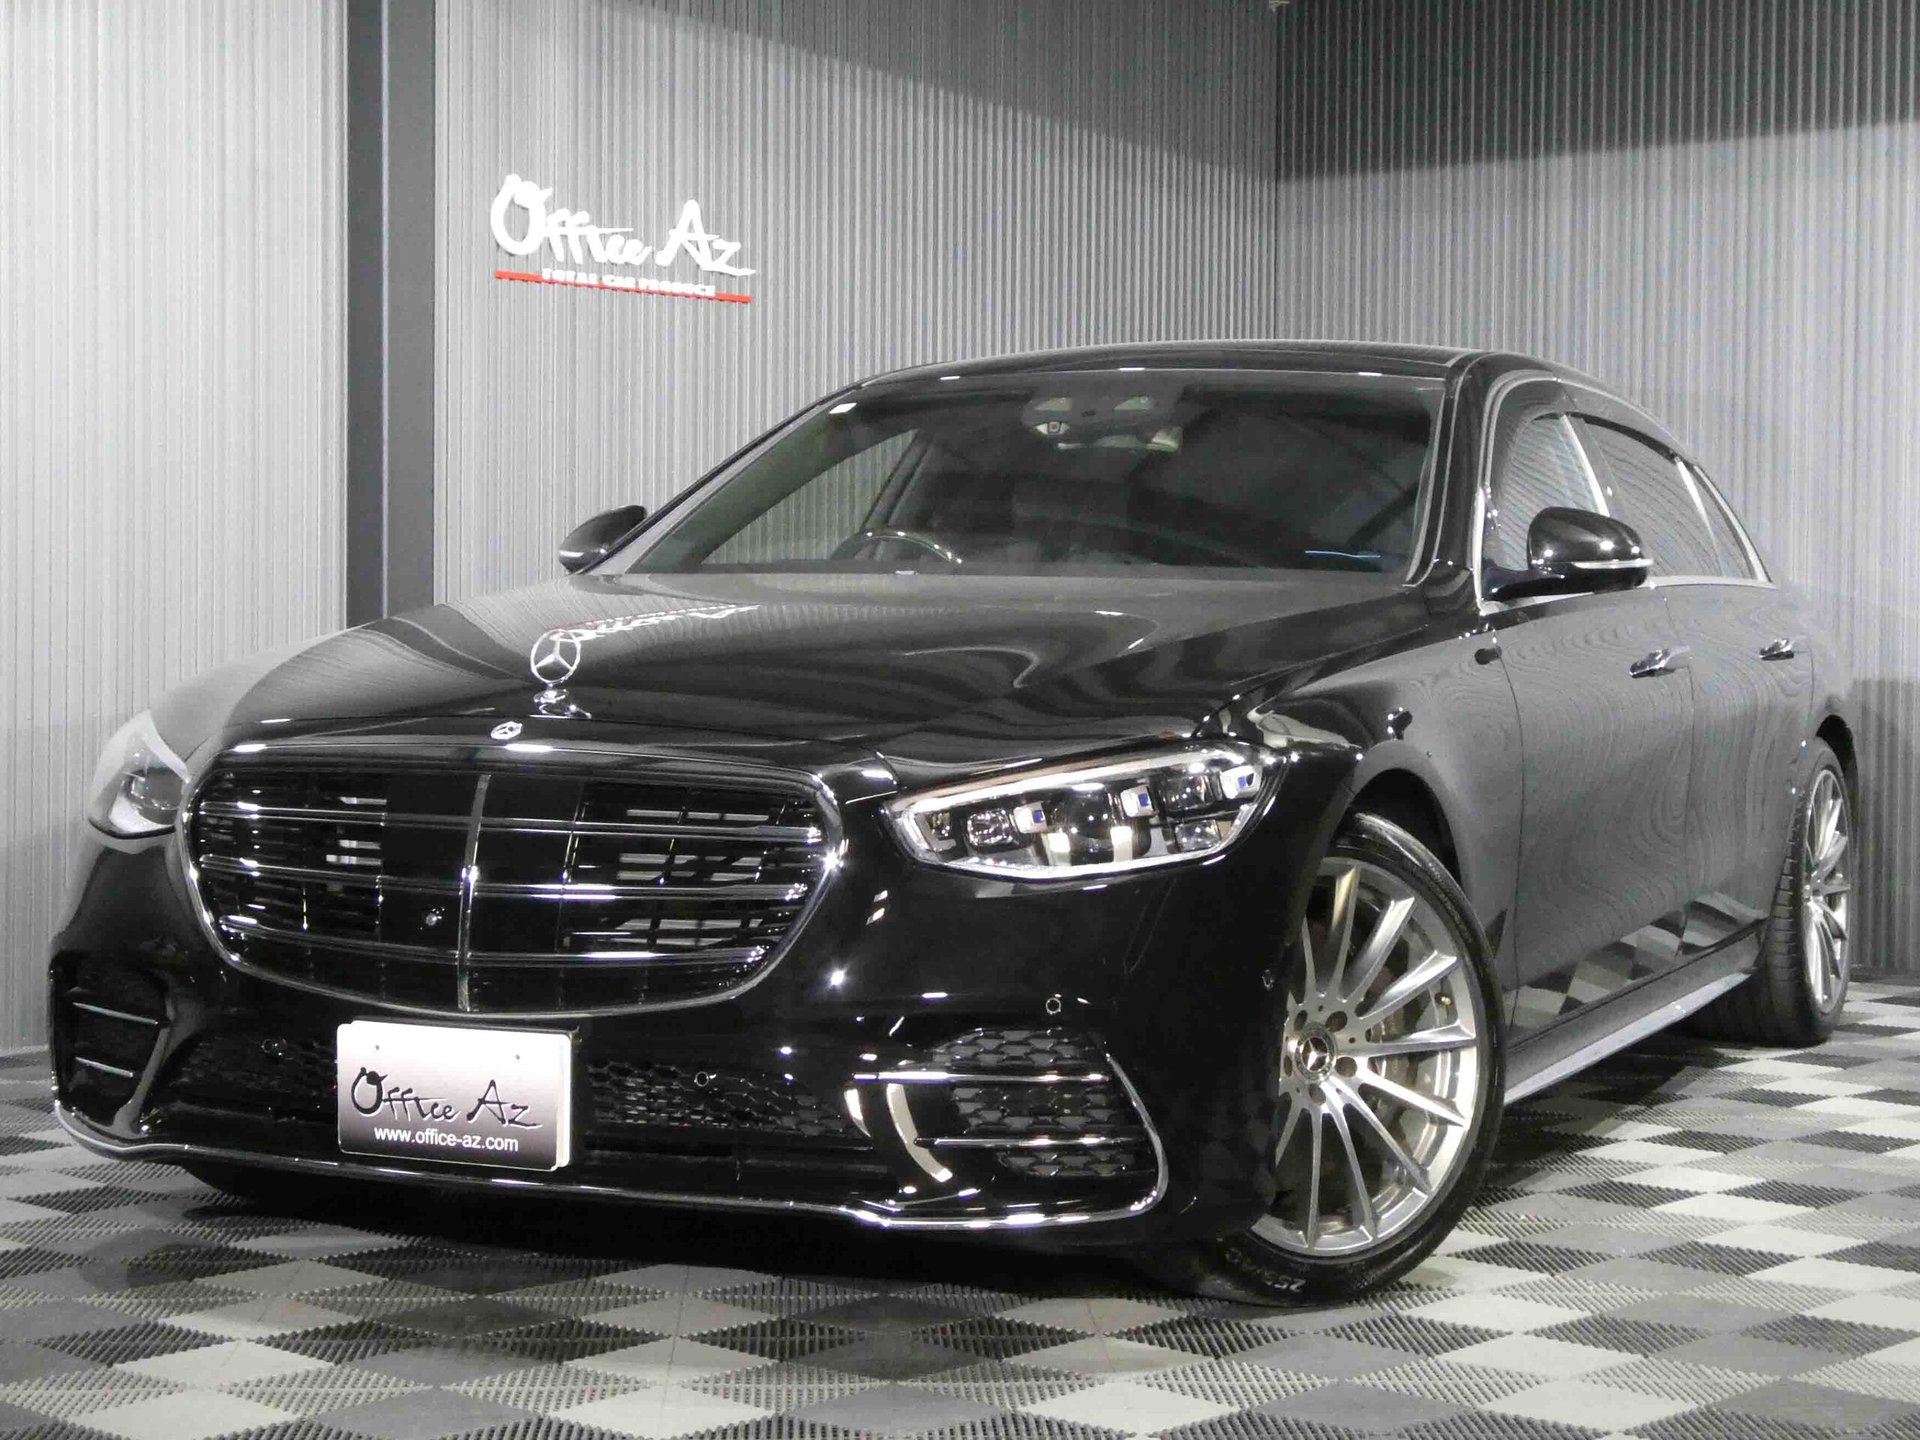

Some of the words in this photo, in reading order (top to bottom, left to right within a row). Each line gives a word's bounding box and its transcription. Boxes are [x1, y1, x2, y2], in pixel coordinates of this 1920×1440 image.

[490, 173, 652, 265] Office
[655, 199, 757, 276] Az
[351, 1067, 458, 1121] Office
[466, 1080, 542, 1129] Az
[373, 1127, 519, 1152] www.office-az.com
